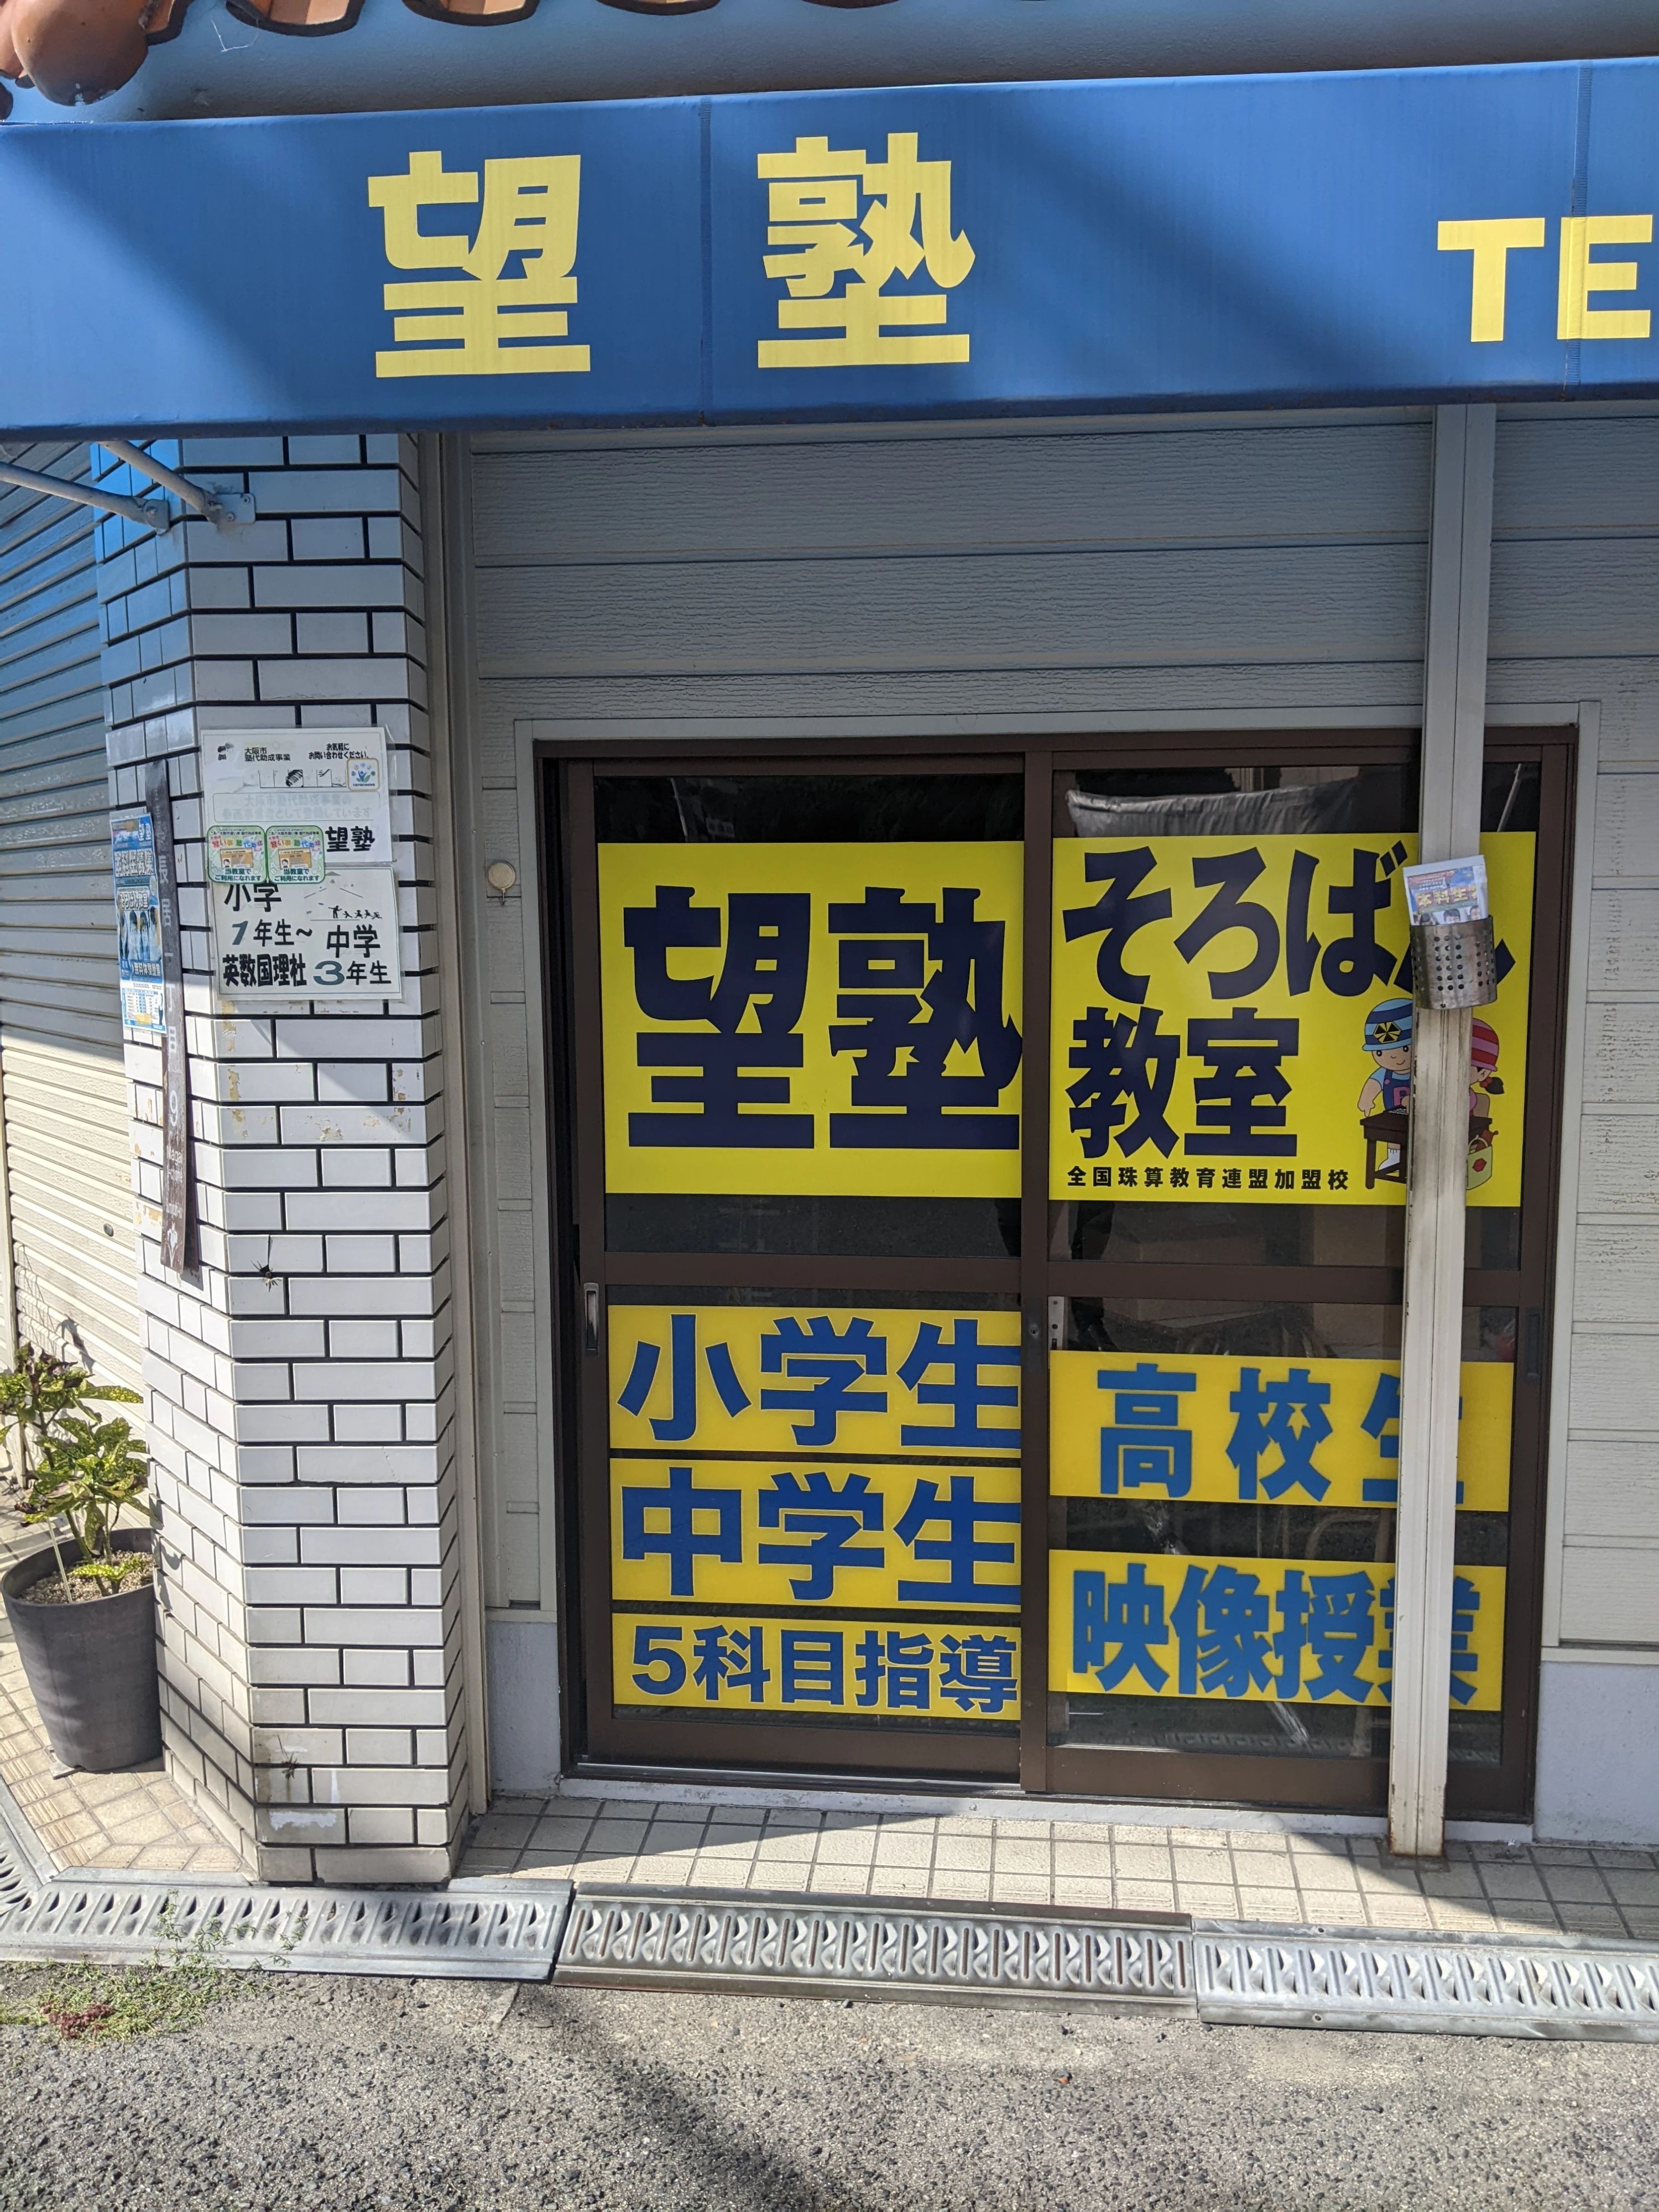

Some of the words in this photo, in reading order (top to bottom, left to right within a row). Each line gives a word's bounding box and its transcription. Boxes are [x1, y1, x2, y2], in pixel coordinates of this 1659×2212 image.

[368, 132, 975, 378] 望塾
[1437, 215, 1652, 342] TE
[326, 743, 349, 751] お気軽に
[325, 826, 375, 853] 望塾
[224, 884, 282, 912] 小学
[222, 953, 307, 987] 英数国理社
[326, 924, 381, 958] 中学
[313, 960, 392, 985] 3年生
[623, 885, 1023, 1150] 望塾
[1065, 1006, 1300, 1159] 教室
[1067, 1166, 1350, 1191] 全国珠算教育連盟加盟校
[617, 1313, 1021, 1449] 小学生
[620, 1467, 1021, 1605] 中学生
[632, 1624, 1019, 1713] 5科目指導
